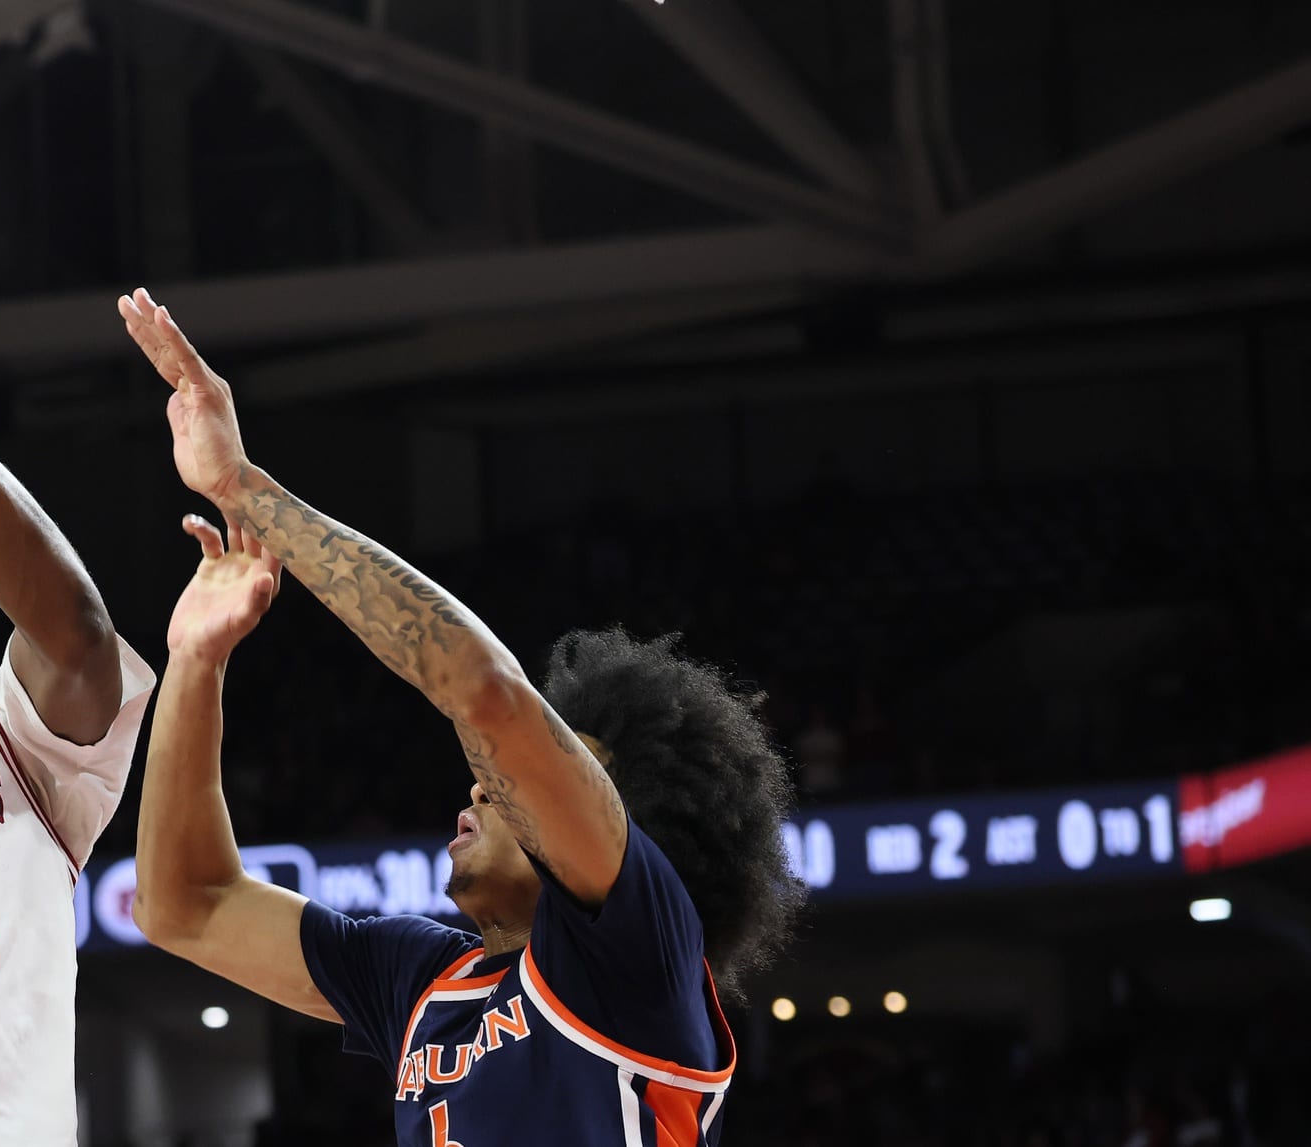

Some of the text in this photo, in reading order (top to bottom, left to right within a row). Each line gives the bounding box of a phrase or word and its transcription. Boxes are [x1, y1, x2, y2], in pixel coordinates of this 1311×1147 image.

[929, 809, 969, 879] 2
[1057, 800, 1097, 870] 0
[1142, 793, 1174, 863] 1
[395, 994, 531, 1102] ABUN
